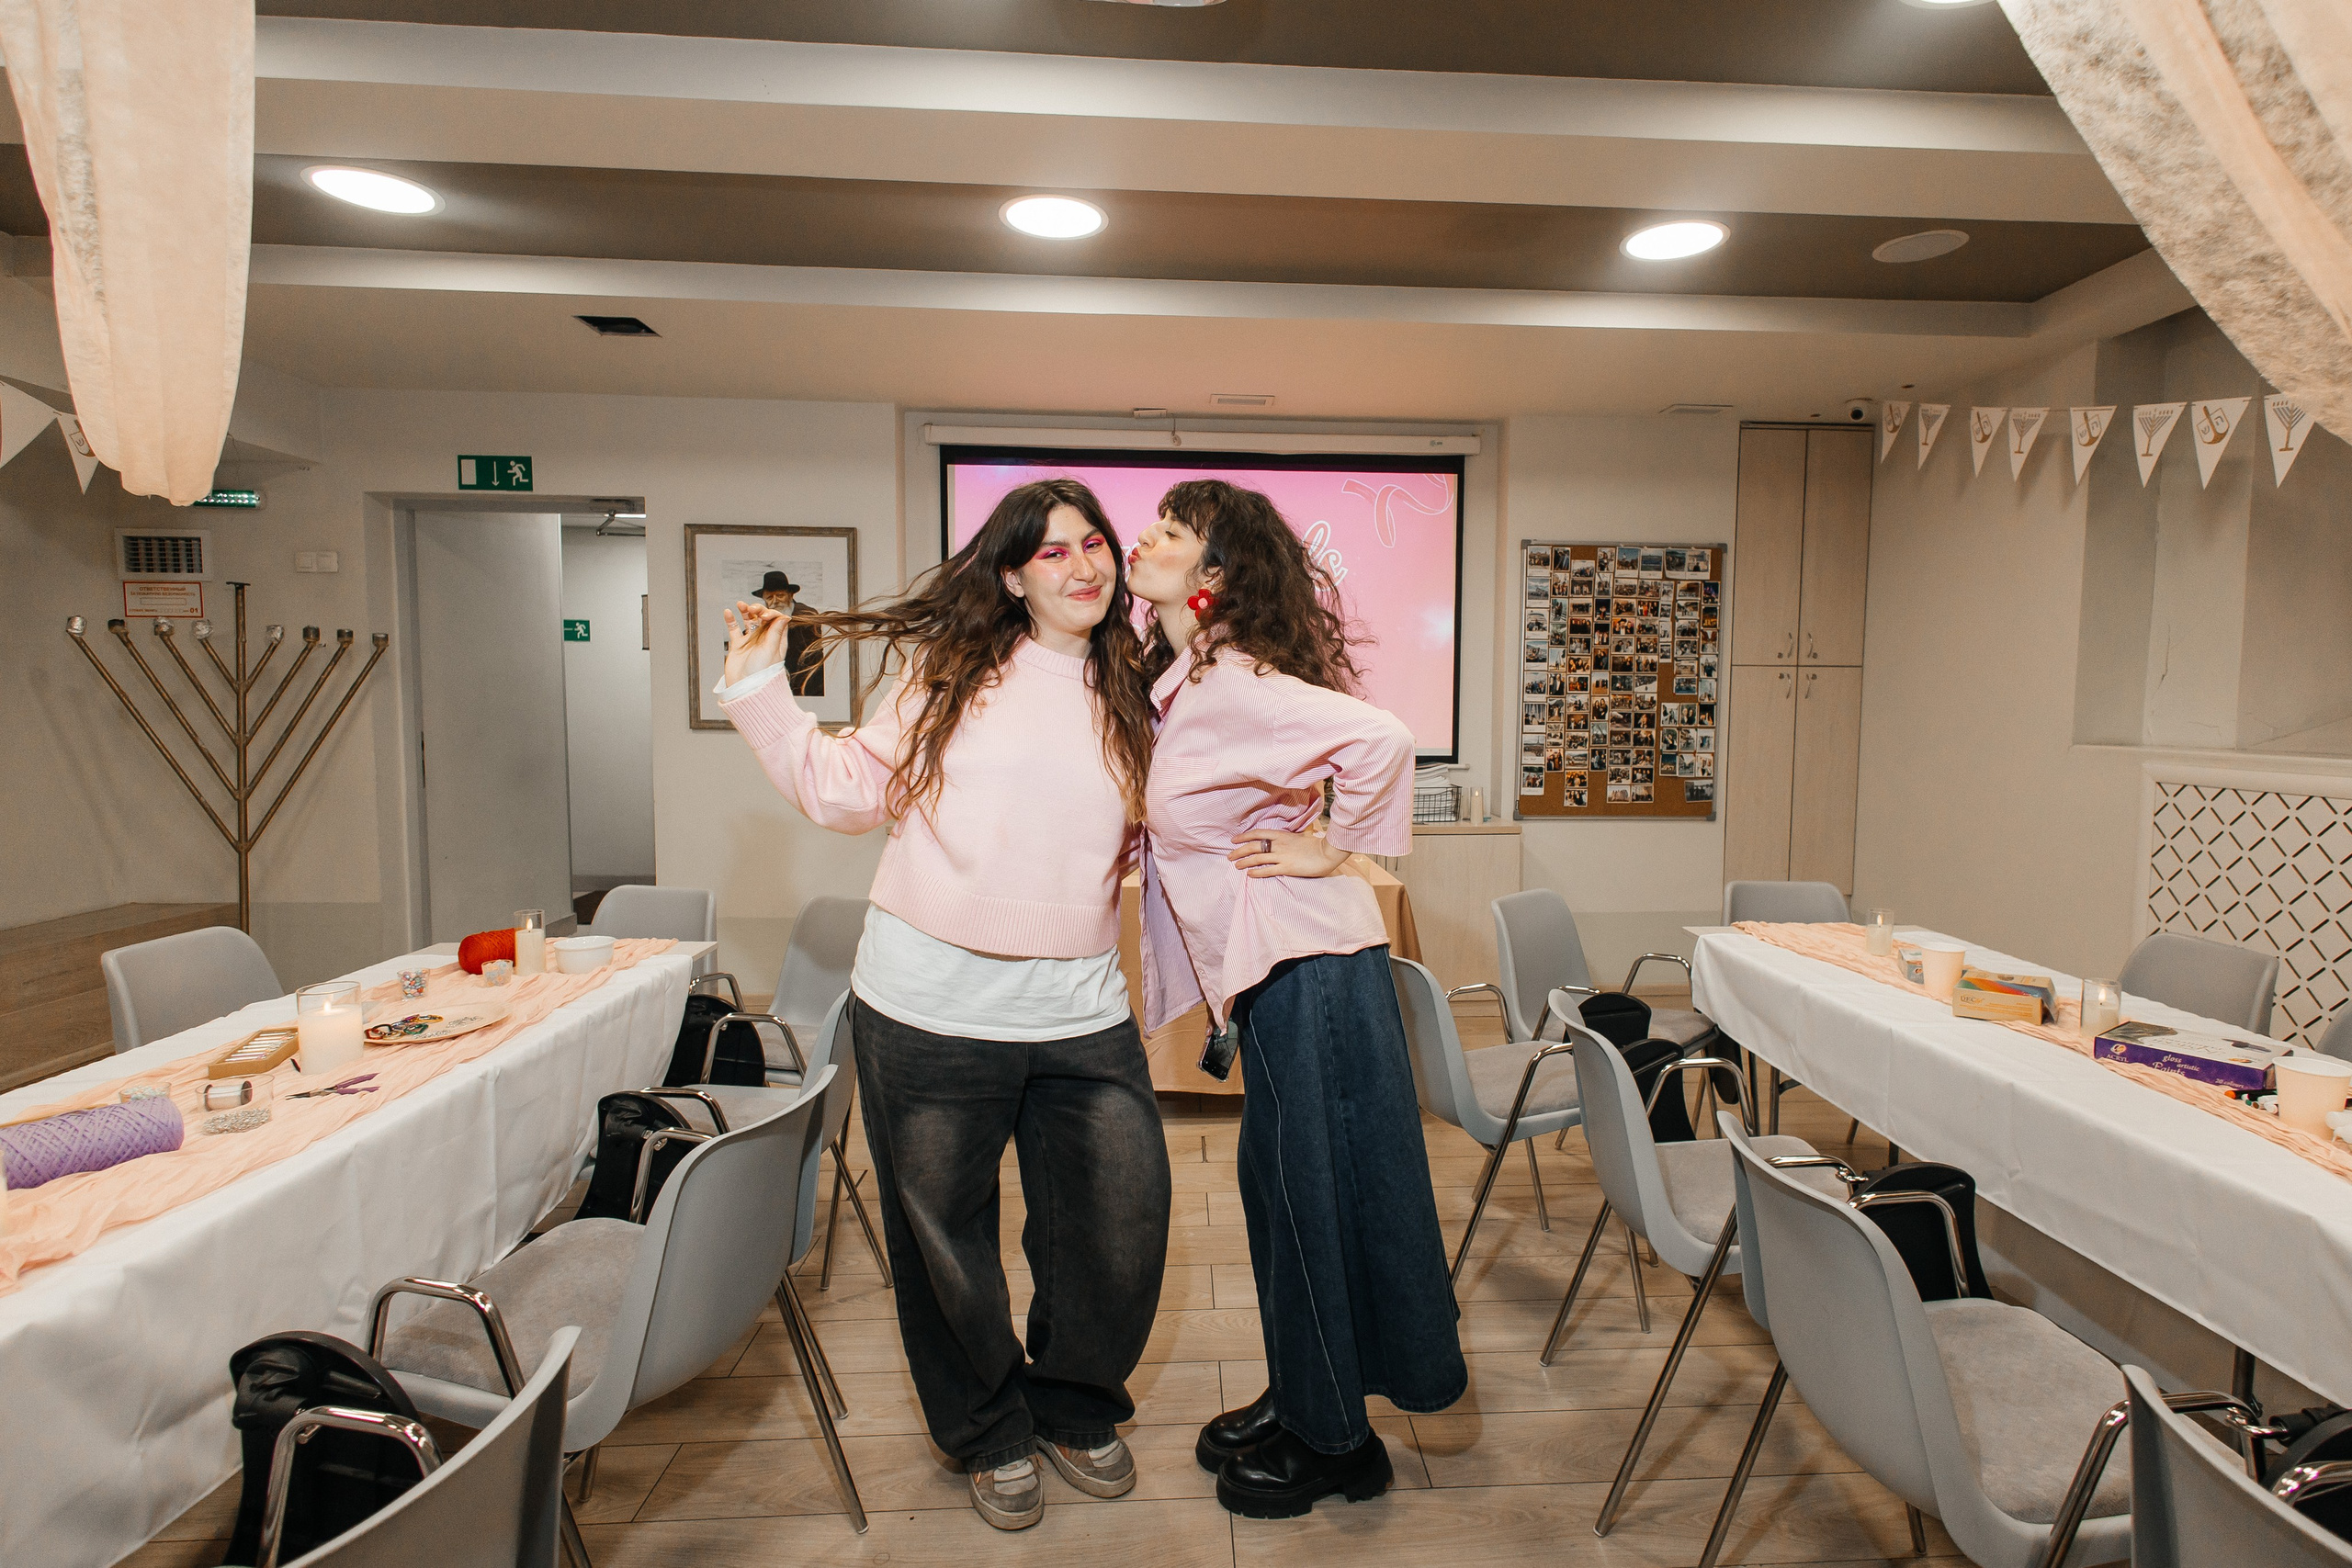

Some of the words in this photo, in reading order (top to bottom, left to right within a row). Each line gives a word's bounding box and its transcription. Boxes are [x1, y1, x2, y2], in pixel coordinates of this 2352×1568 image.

[2106, 1054, 2130, 1063] ACRYL
[2162, 1055, 2183, 1064] gloss
[2177, 1063, 2201, 1072] artistic
